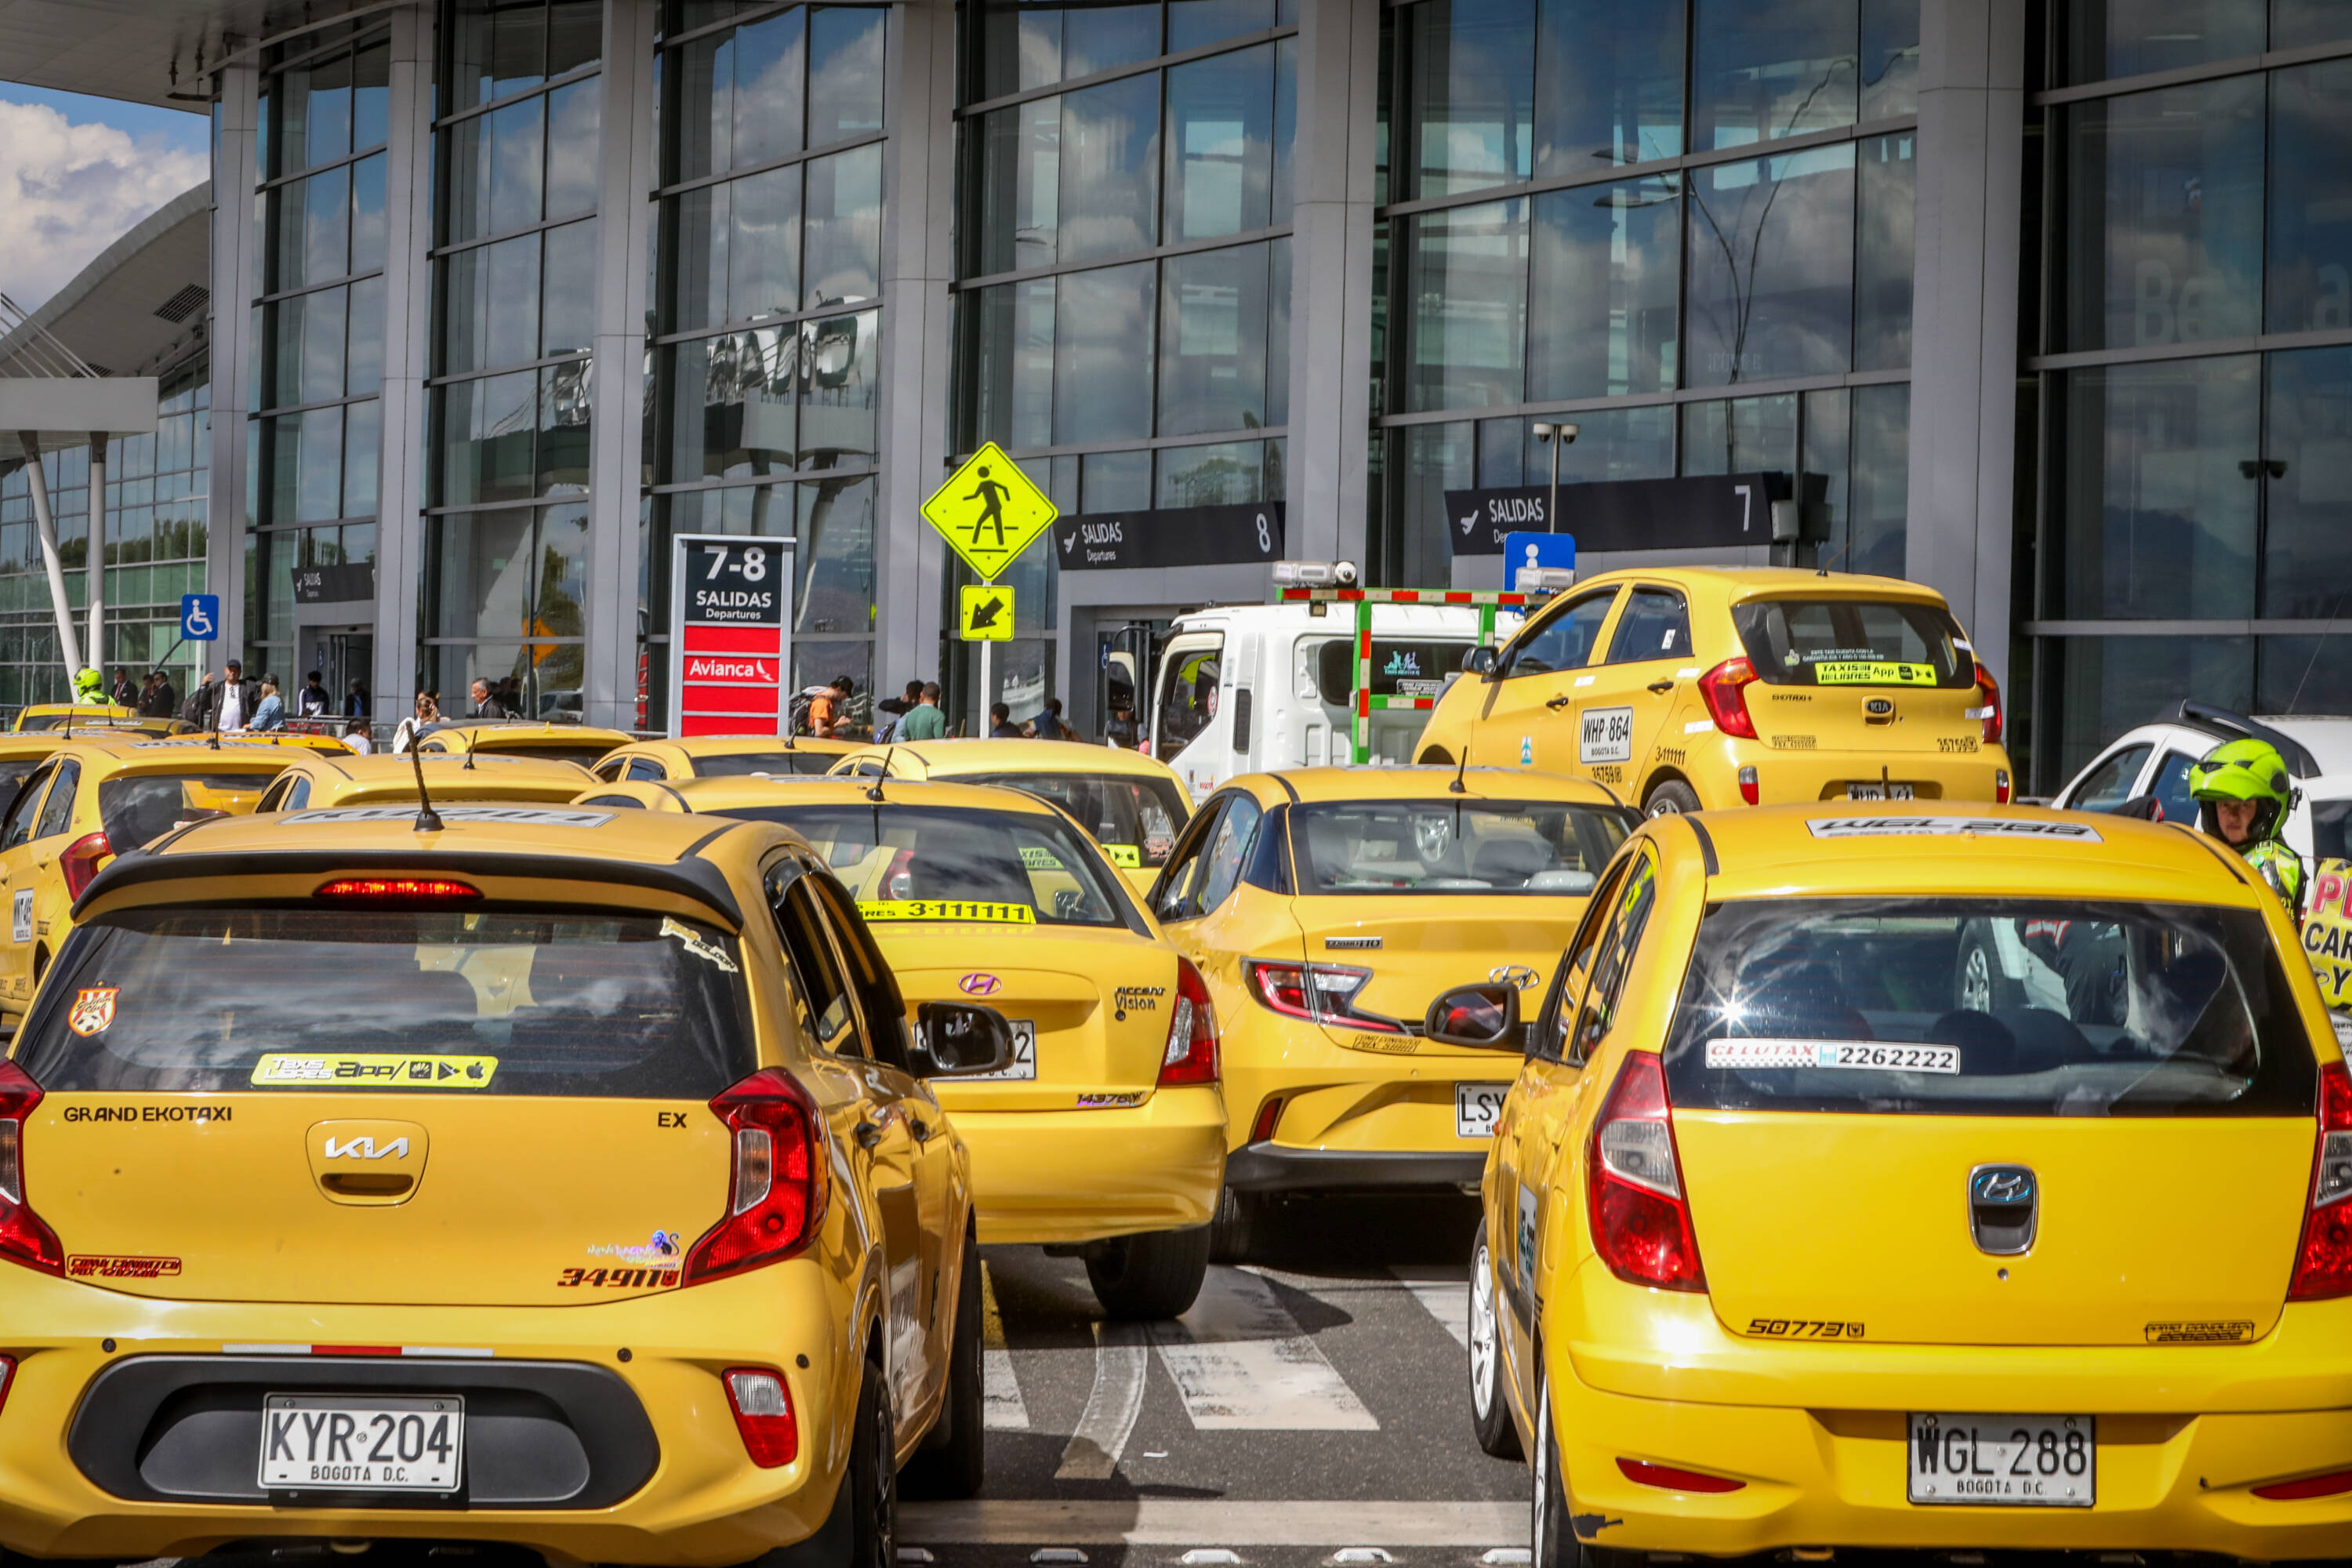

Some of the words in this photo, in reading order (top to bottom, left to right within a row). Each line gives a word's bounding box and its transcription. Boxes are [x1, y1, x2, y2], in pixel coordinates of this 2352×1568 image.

[1489, 497, 1544, 523] SALIDAS
[1735, 485, 1751, 532] 7
[1082, 521, 1122, 544] SALIDAS
[1256, 513, 1271, 553] 8
[705, 546, 766, 582] 7-8
[1087, 549, 1116, 564] Departures
[696, 590, 771, 608] SALIDAS
[706, 608, 761, 621] Departures
[689, 659, 754, 676] Avianca
[1873, 667, 1894, 677] App
[1871, 702, 1889, 712] KIA
[1584, 717, 1605, 743] WHP
[1609, 715, 1629, 741] 864
[1591, 747, 1610, 757] BOGOTA
[1656, 746, 1686, 765] 3-111111
[908, 902, 1025, 920] 3-111111
[1839, 1047, 1953, 1069] 2262222
[64, 1106, 138, 1122] GRAND
[143, 1106, 232, 1122] EKOTAXI
[659, 1112, 688, 1128] EX
[557, 1268, 662, 1287] 34911
[1747, 1319, 1845, 1337] 50773
[269, 1412, 356, 1462] KYR
[368, 1413, 453, 1464] 204
[1917, 1426, 1994, 1475] WGL
[2009, 1428, 2086, 1475] 288
[310, 1465, 371, 1480] BOGOTA
[383, 1467, 409, 1482] D.C.
[1957, 1479, 2012, 1494] BOGOTA
